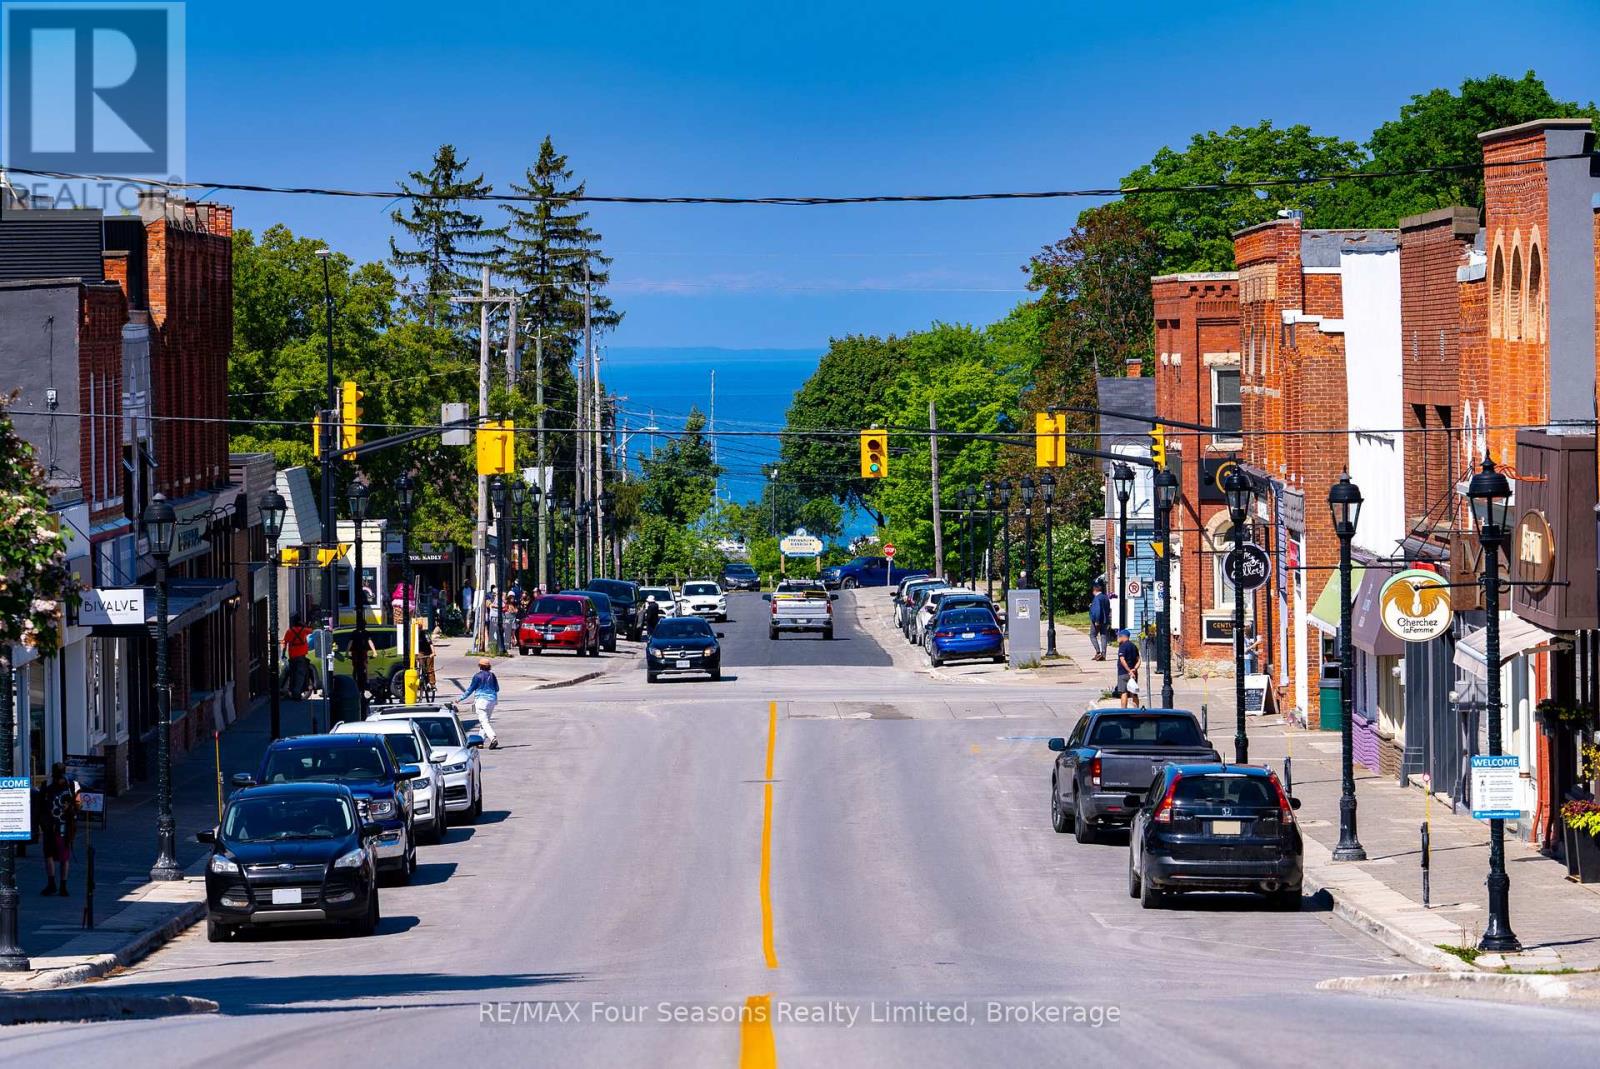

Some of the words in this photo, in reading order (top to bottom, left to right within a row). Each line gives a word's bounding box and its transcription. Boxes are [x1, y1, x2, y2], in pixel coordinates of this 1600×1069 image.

[84, 600, 138, 612] BIVALVE
[1397, 617, 1438, 627] Cherchez
[1473, 758, 1518, 767] WELCOME
